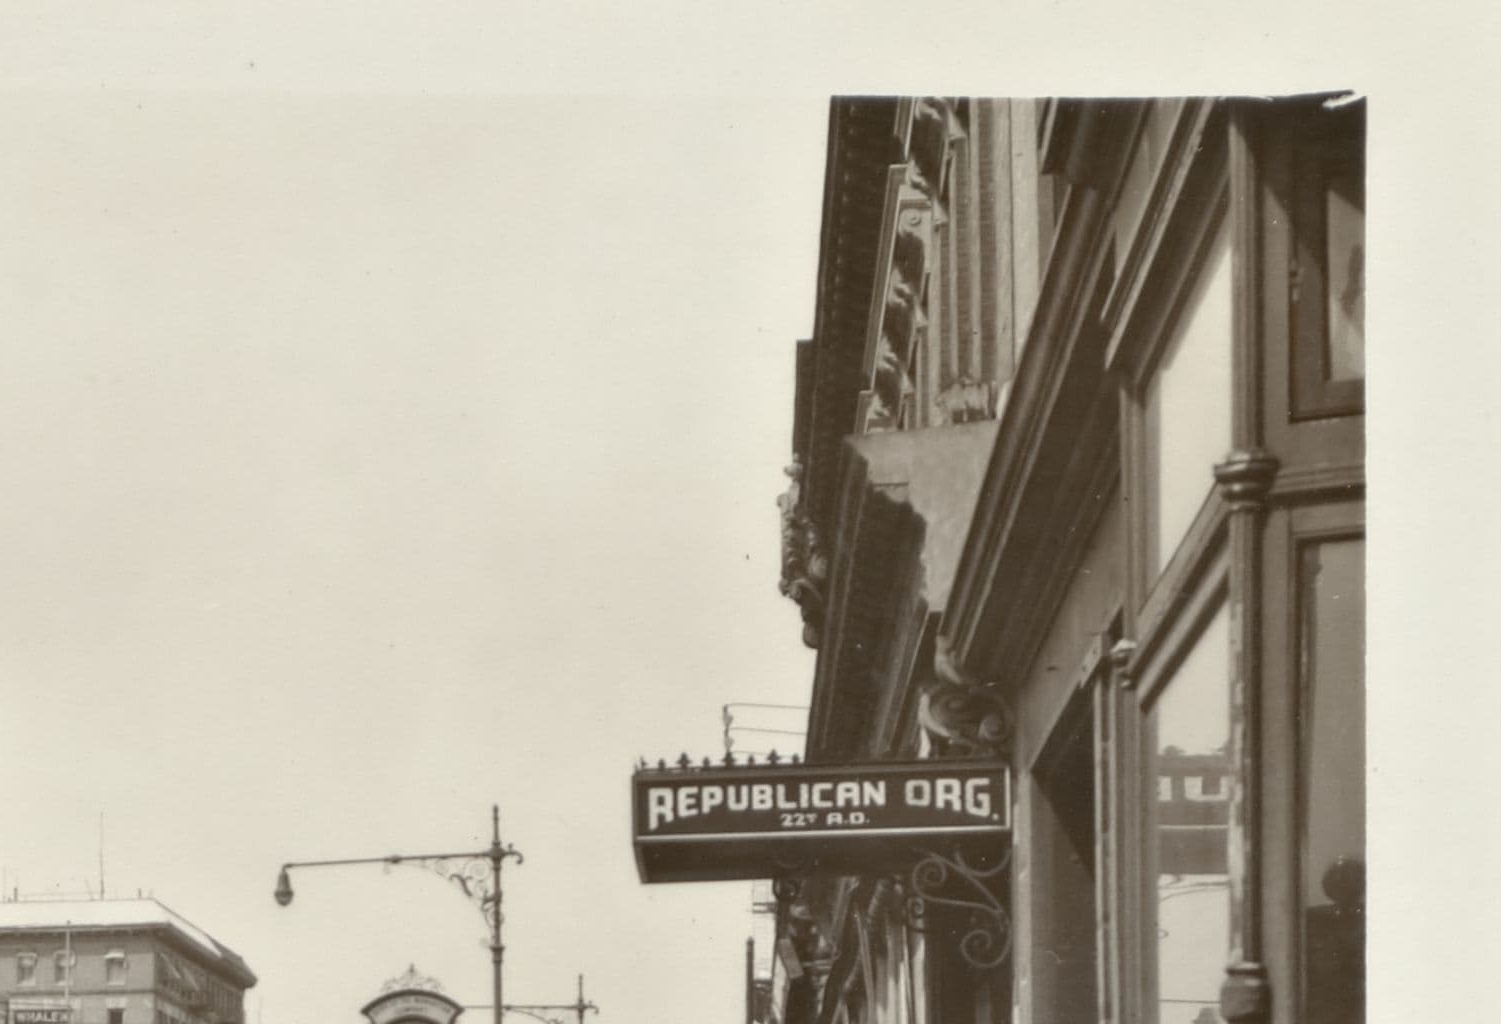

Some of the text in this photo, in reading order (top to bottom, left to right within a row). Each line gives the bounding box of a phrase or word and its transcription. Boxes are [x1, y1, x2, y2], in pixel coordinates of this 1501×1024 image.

[647, 775, 1000, 831] REPUBLICAN ORG.
[826, 811, 871, 827] A.D.
